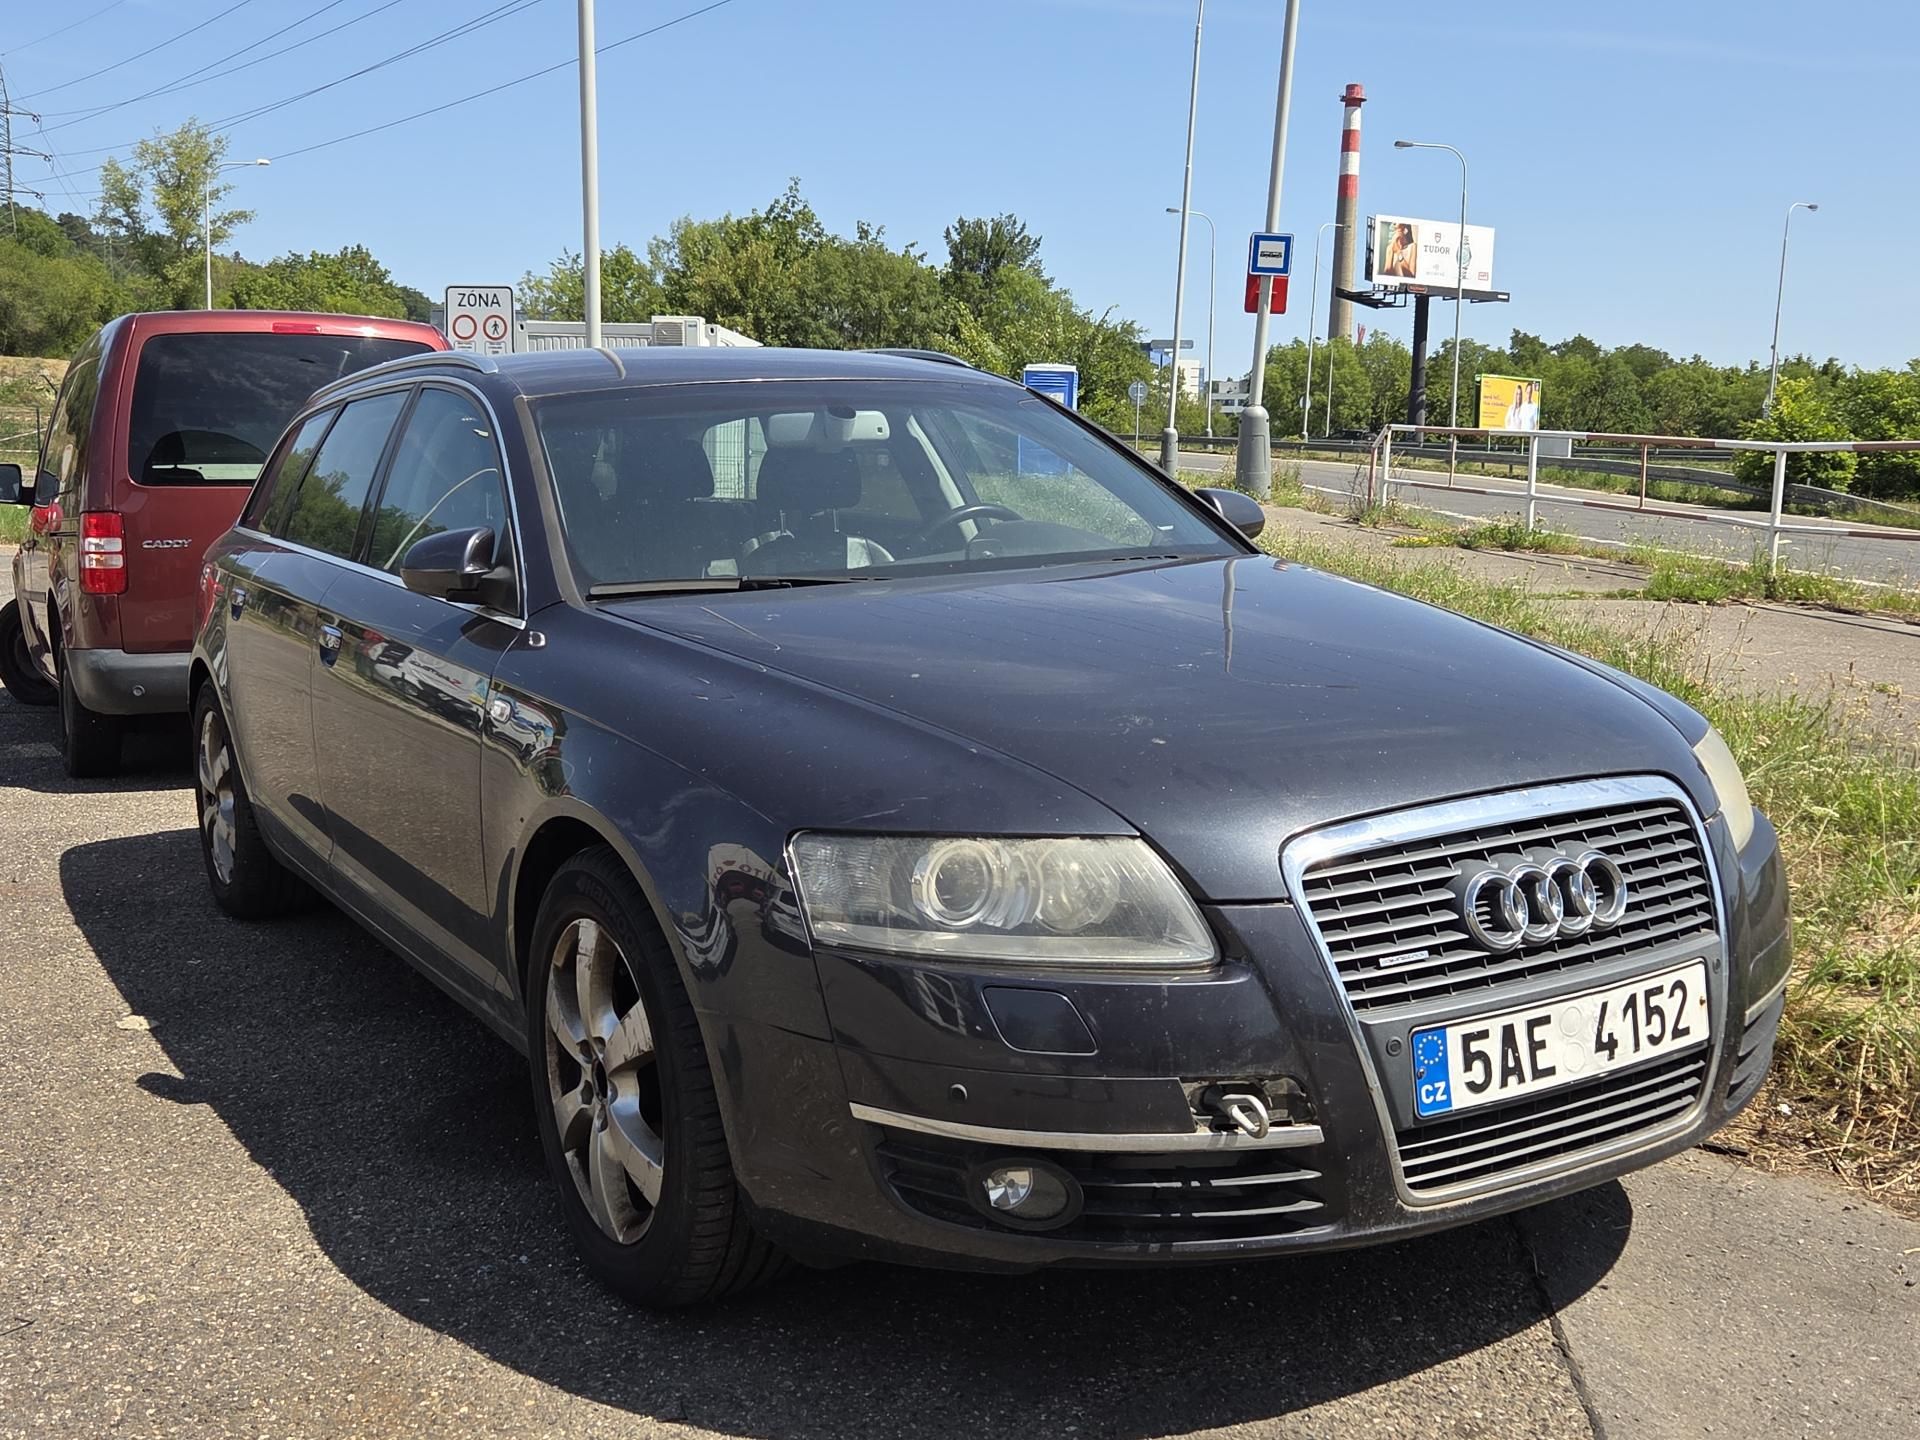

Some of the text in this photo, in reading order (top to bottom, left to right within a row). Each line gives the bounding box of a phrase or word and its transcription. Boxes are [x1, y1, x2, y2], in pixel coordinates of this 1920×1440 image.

[1423, 245, 1450, 255] TUDOR
[457, 289, 501, 308] ZÓNA
[142, 539, 192, 548] CADDY
[1461, 979, 1691, 1094] 5AE 4152
[1420, 1081, 1447, 1104] CZ
